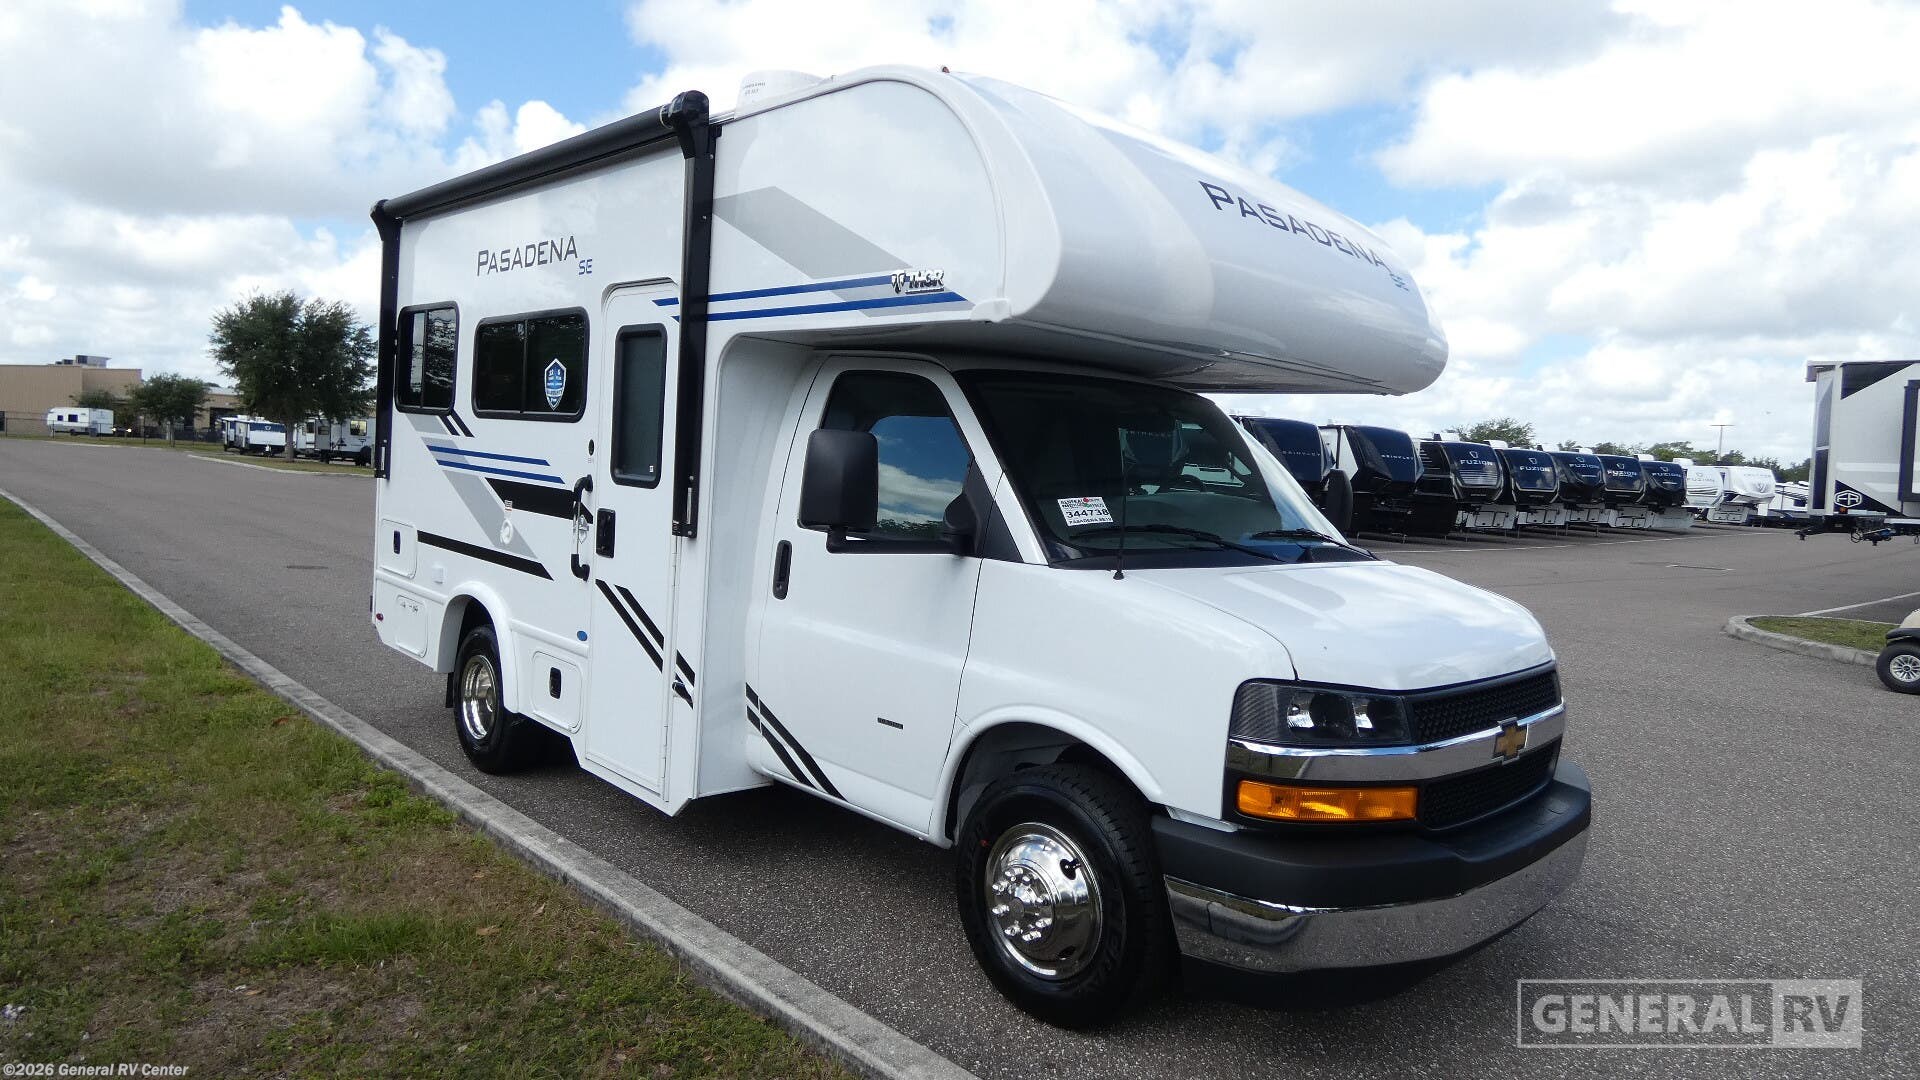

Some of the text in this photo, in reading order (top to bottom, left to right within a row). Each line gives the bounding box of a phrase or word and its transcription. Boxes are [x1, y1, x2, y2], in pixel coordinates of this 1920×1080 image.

[1198, 180, 1393, 273] PASADENA
[477, 235, 578, 276] PASADENA
[578, 259, 593, 275] SE
[1065, 508, 1110, 519] 344738
